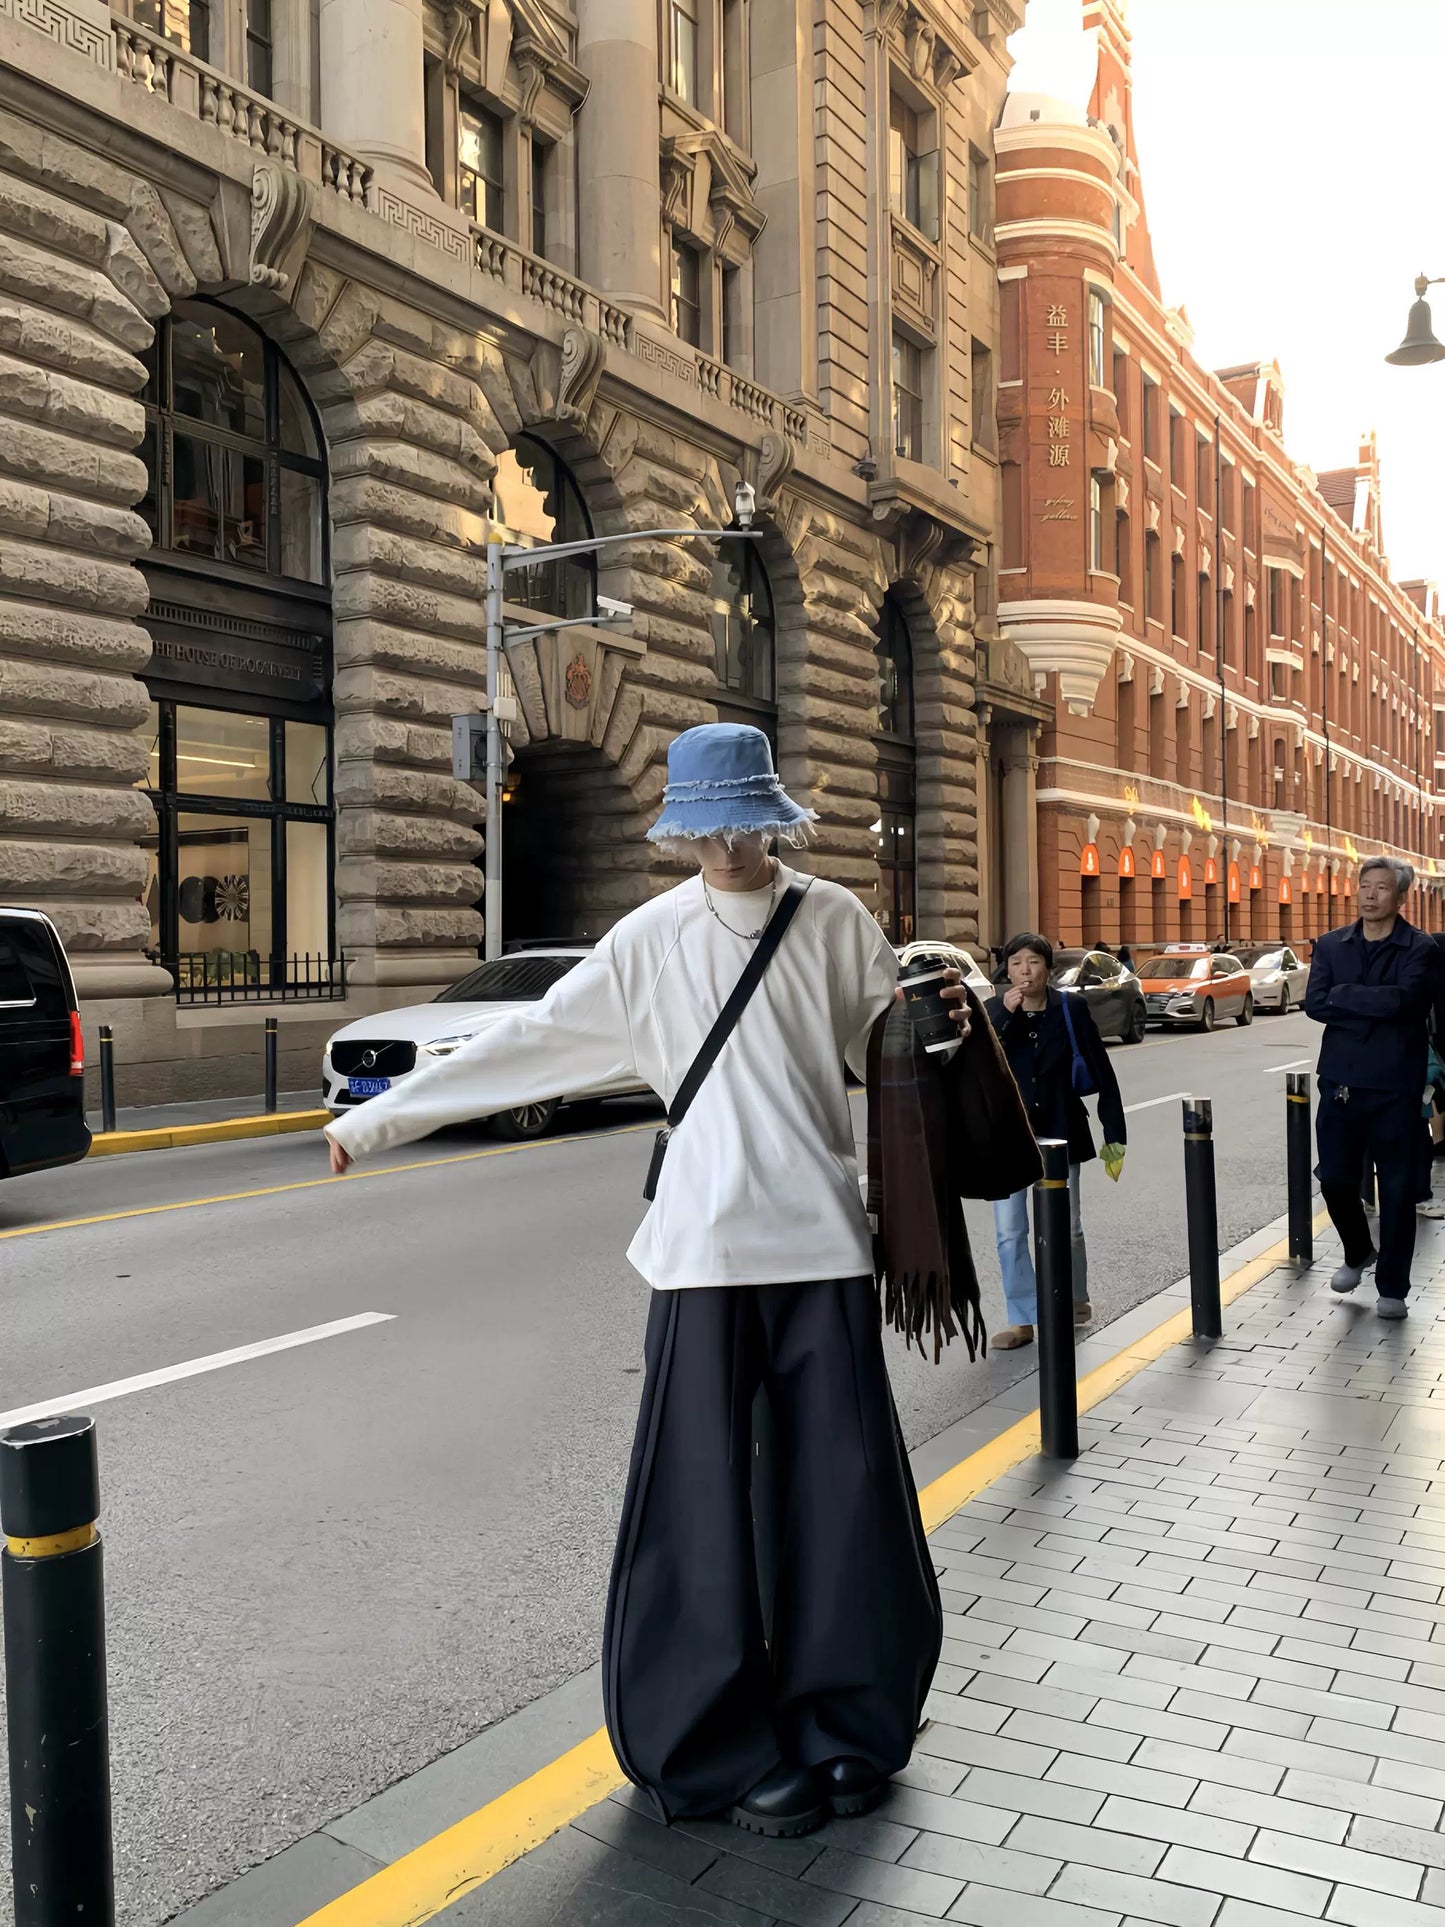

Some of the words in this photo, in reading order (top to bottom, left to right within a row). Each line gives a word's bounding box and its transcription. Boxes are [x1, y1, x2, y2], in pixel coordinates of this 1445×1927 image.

[152, 640, 172, 657] HE
[176, 645, 217, 666] HOUSE
[221, 652, 237, 670] OF
